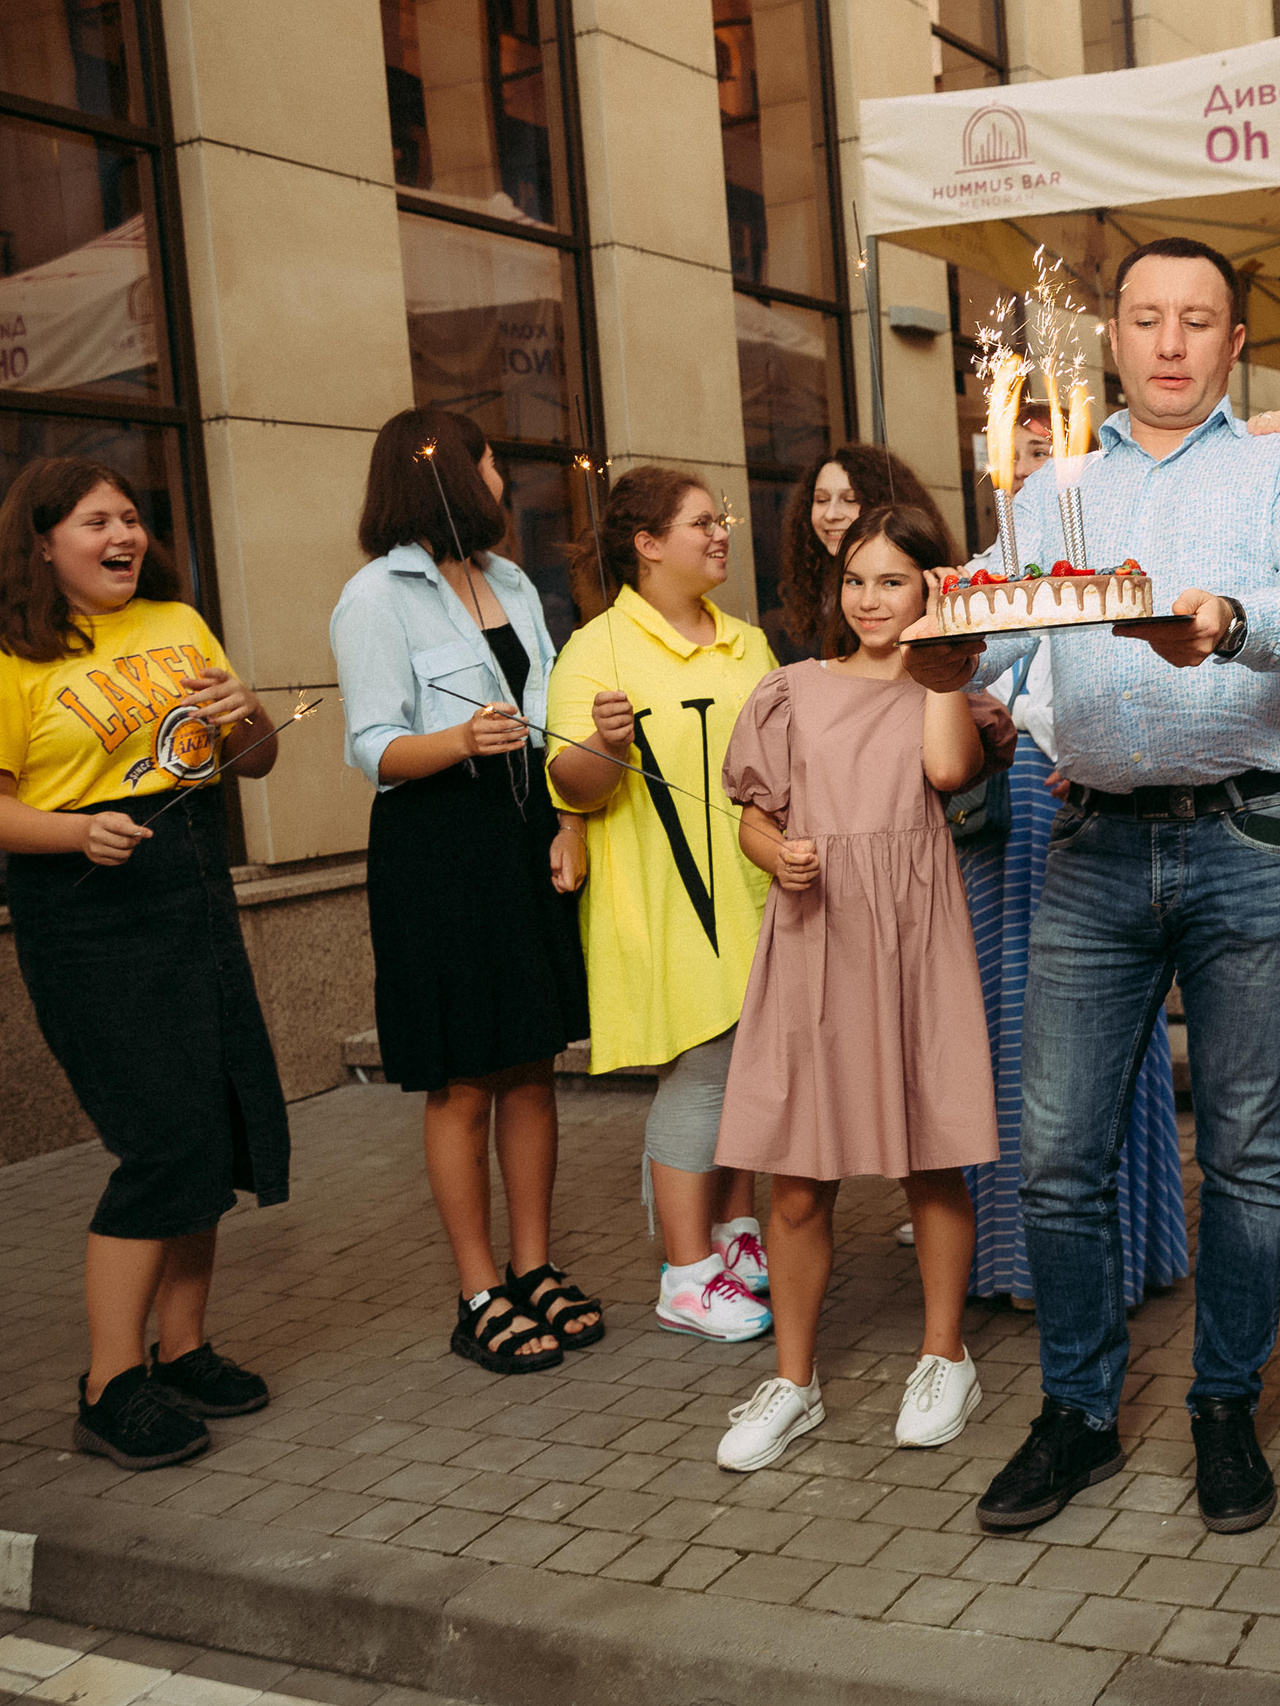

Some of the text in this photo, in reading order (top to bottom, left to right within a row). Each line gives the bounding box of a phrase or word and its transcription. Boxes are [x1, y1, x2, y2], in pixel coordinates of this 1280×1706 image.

[1205, 120, 1269, 163] Oh
[932, 171, 1061, 200] HUMMUS BAR
[130, 759, 151, 780] SINCE
